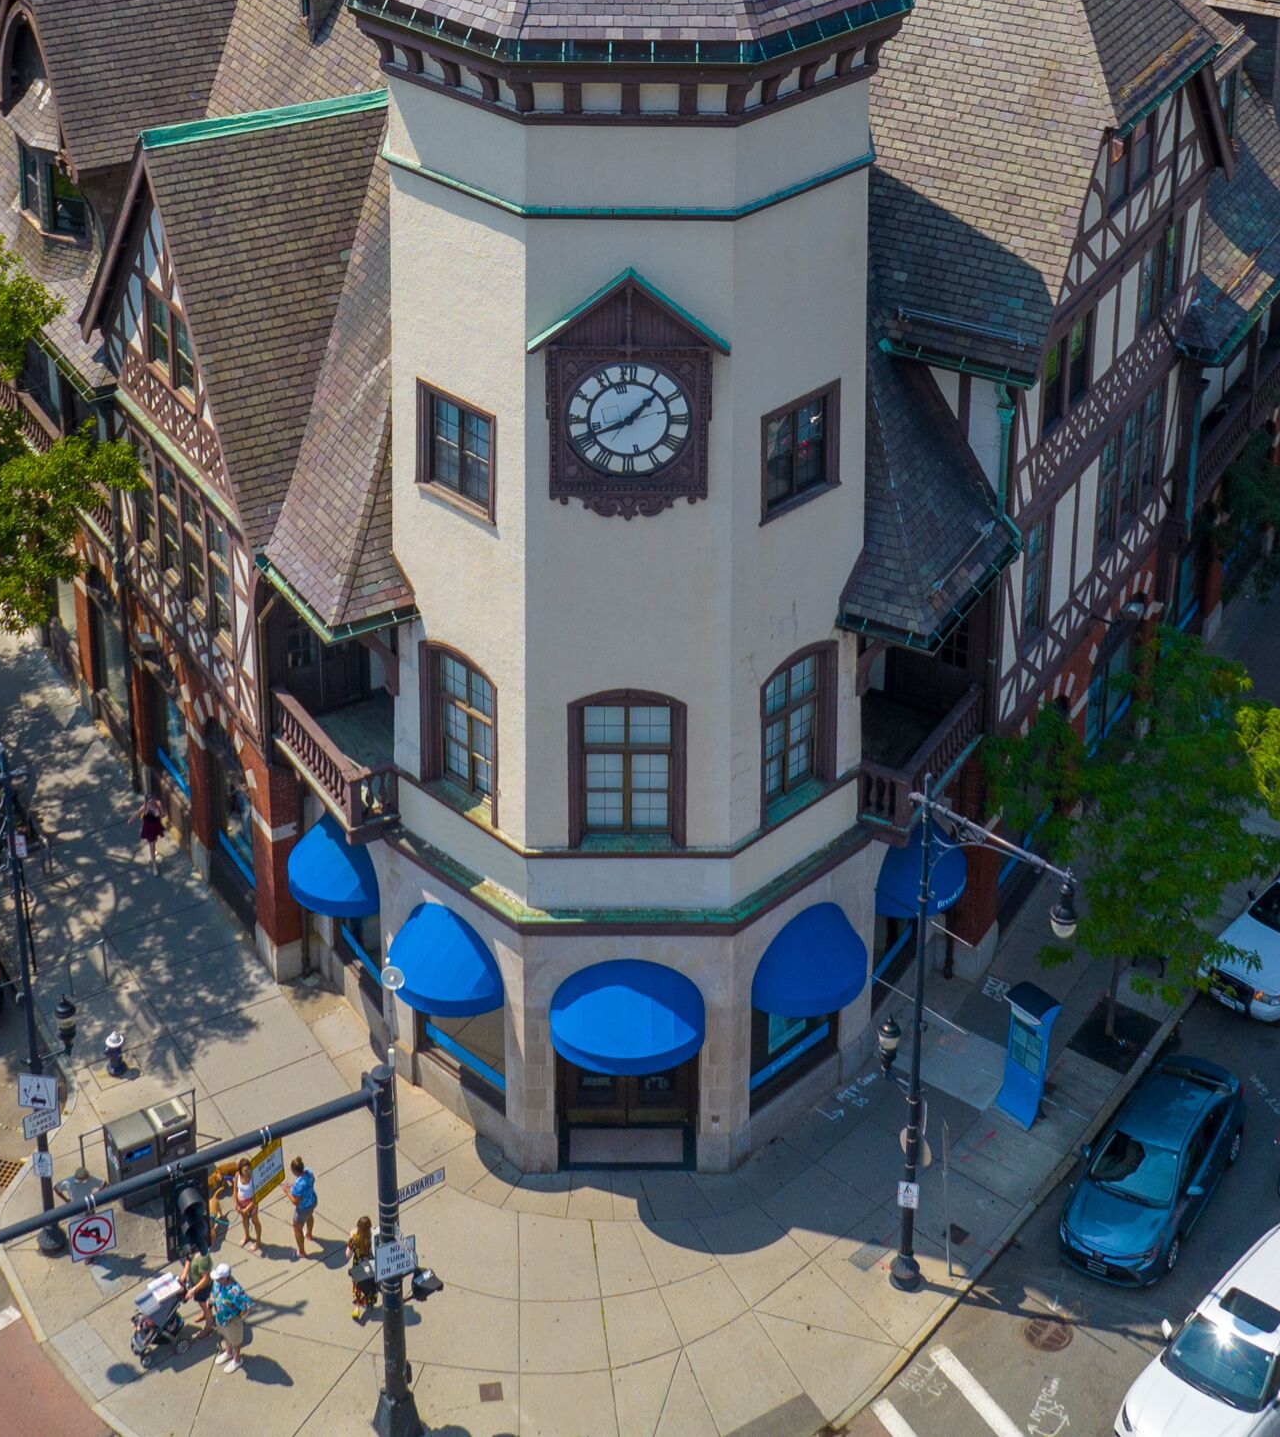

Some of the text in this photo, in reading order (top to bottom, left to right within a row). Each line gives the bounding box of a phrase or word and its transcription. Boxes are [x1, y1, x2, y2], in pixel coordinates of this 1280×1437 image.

[32, 1115, 53, 1128] LANES
[40, 1120, 58, 1132] PASS
[399, 1174, 435, 1200] HARVARD
[389, 1245, 400, 1254] NO
[386, 1253, 406, 1265] TURN
[380, 1260, 412, 1276] ON RED
